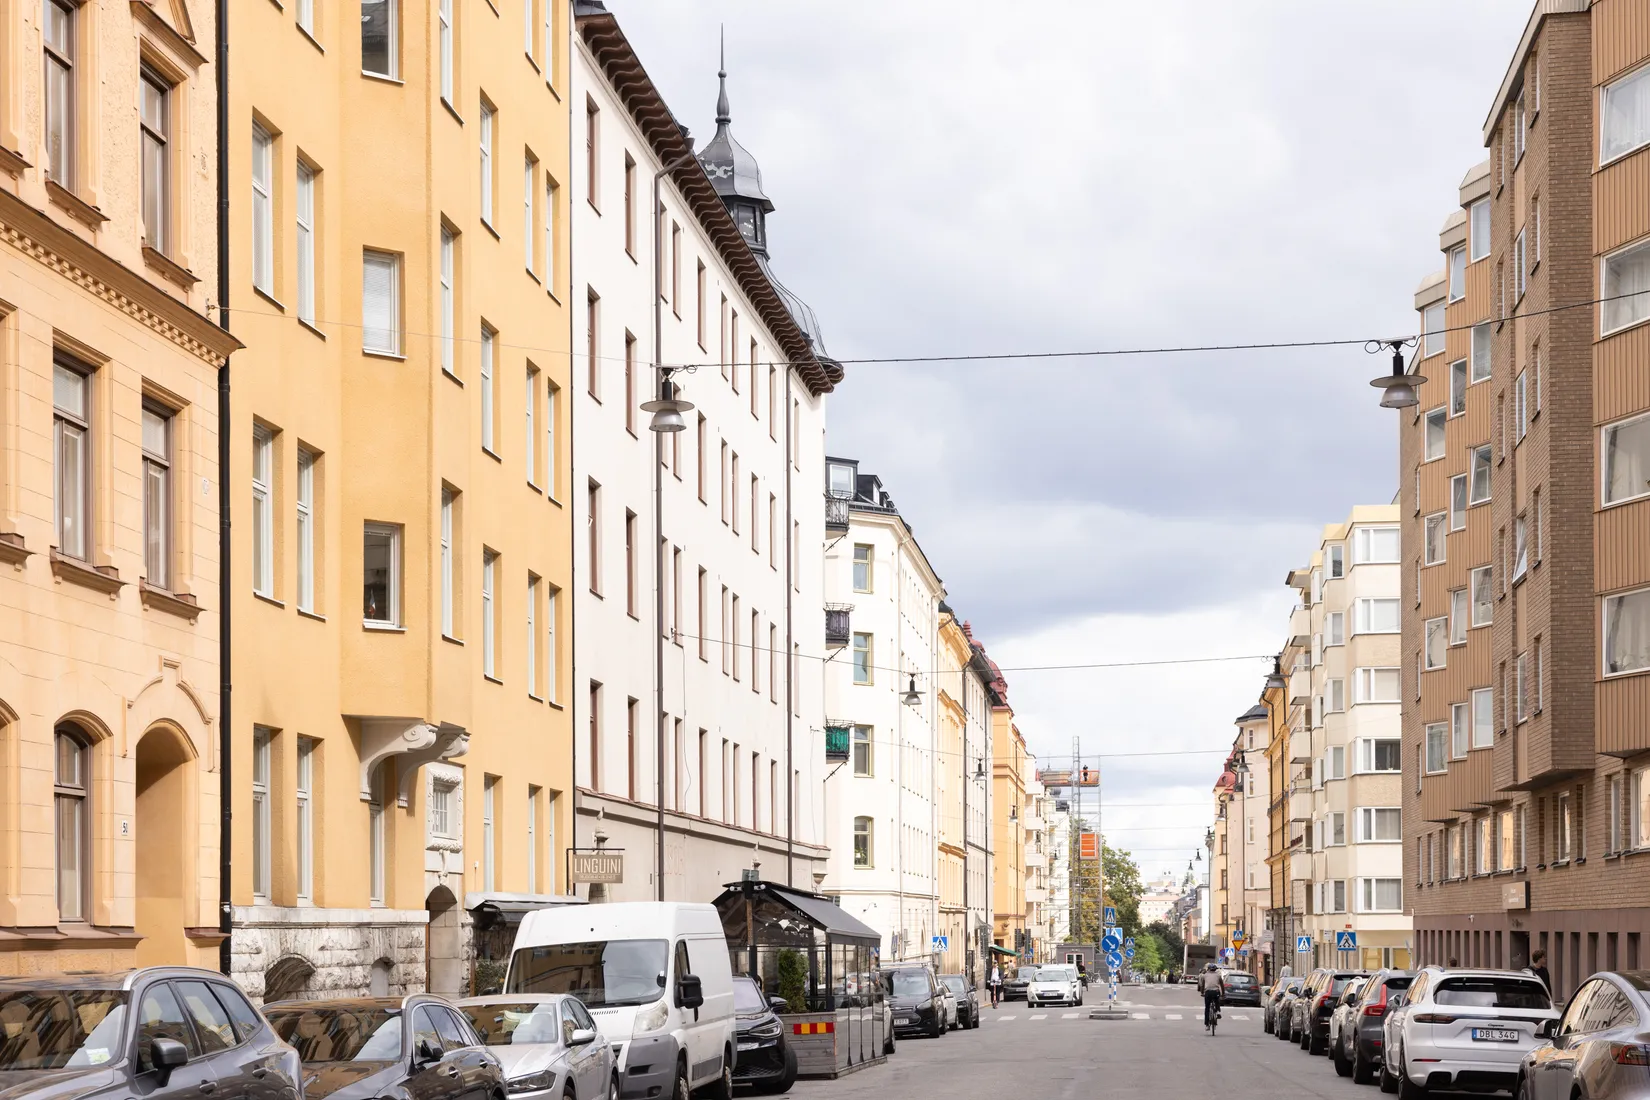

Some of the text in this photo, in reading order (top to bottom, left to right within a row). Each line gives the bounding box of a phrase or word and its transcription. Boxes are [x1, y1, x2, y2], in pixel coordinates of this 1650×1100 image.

[574, 858, 621, 874] LINGUINI
[1479, 1030, 1515, 1039] DBL 34G
